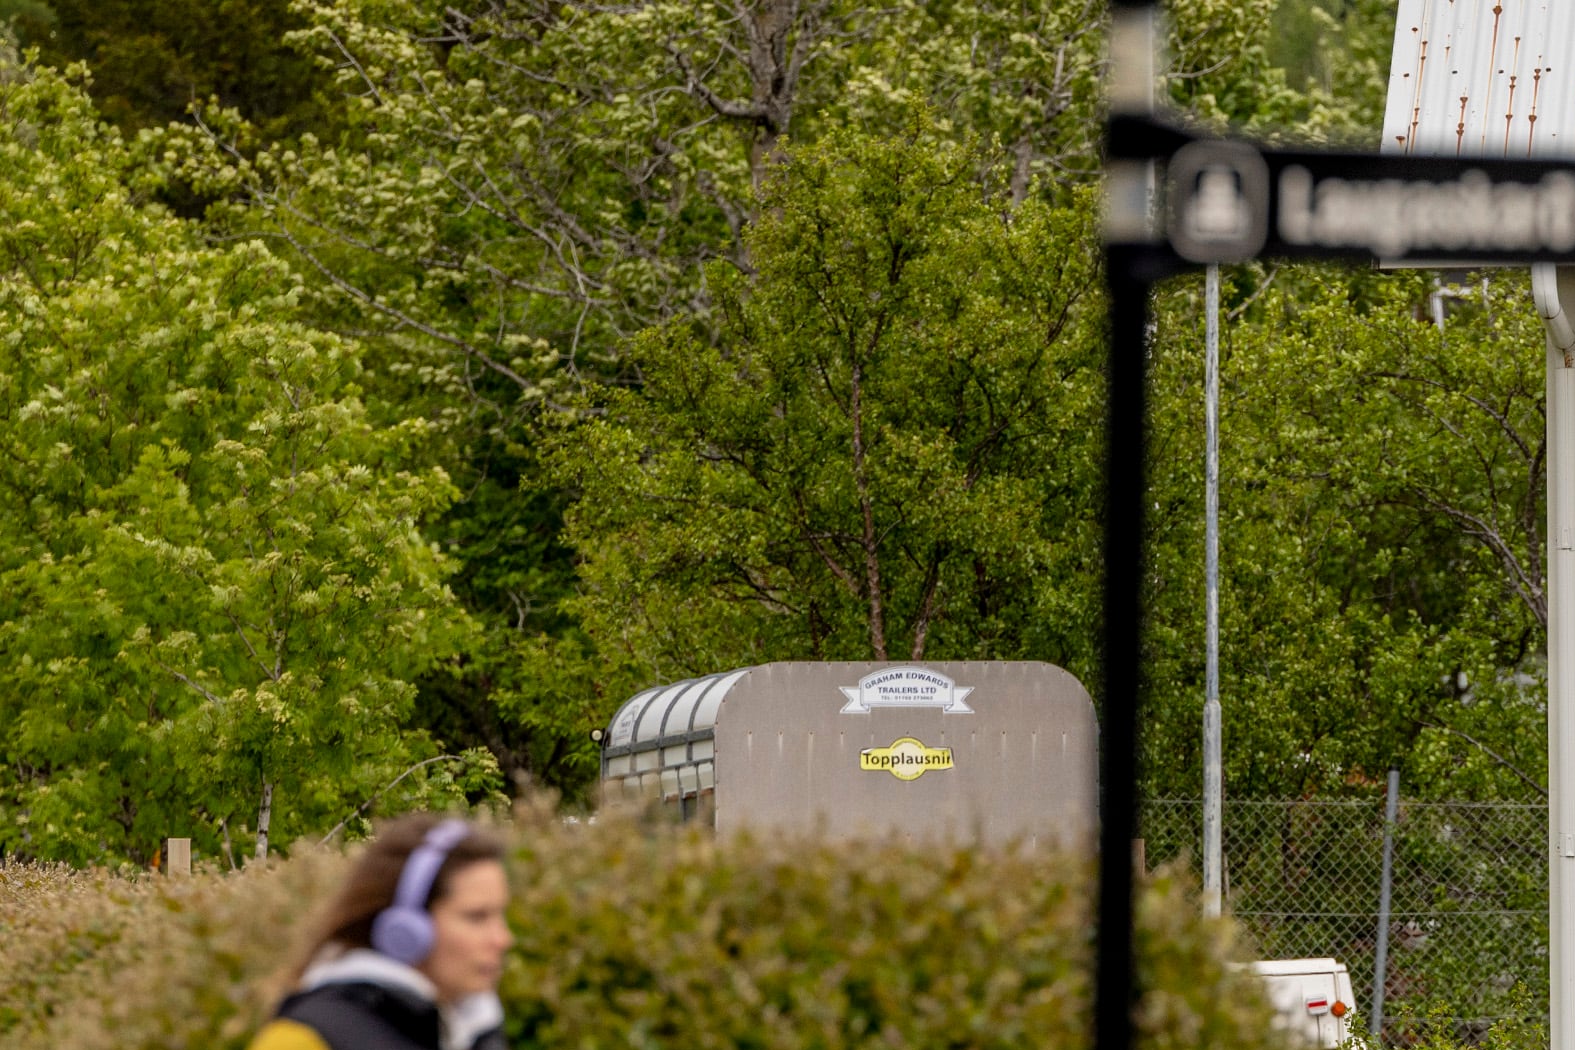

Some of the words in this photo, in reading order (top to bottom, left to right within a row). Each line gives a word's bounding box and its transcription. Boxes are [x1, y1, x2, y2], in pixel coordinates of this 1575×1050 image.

[864, 672, 903, 689] GRAHAM
[906, 672, 949, 689] EDWARDS
[862, 751, 950, 768] Topplausnir
